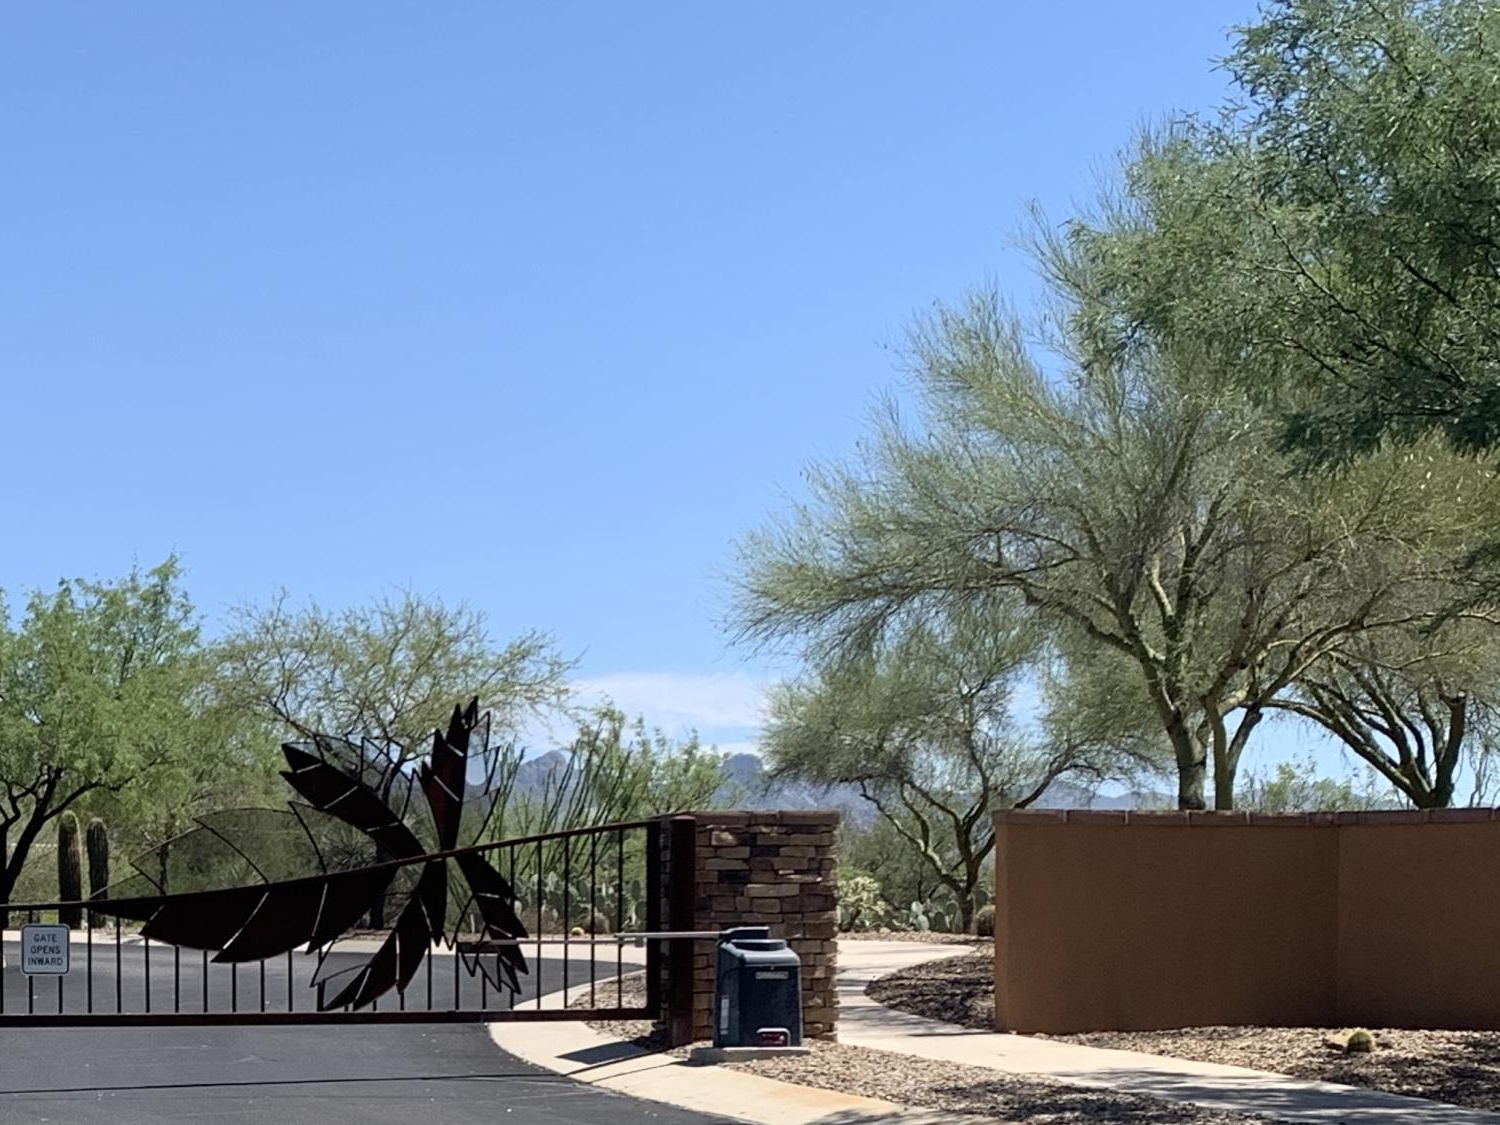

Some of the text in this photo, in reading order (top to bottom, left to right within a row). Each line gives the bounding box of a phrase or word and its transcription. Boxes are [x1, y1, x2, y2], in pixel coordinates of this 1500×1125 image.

[33, 933, 57, 943] GATE
[30, 945, 61, 954] OPENS
[28, 957, 63, 966] INWARD
